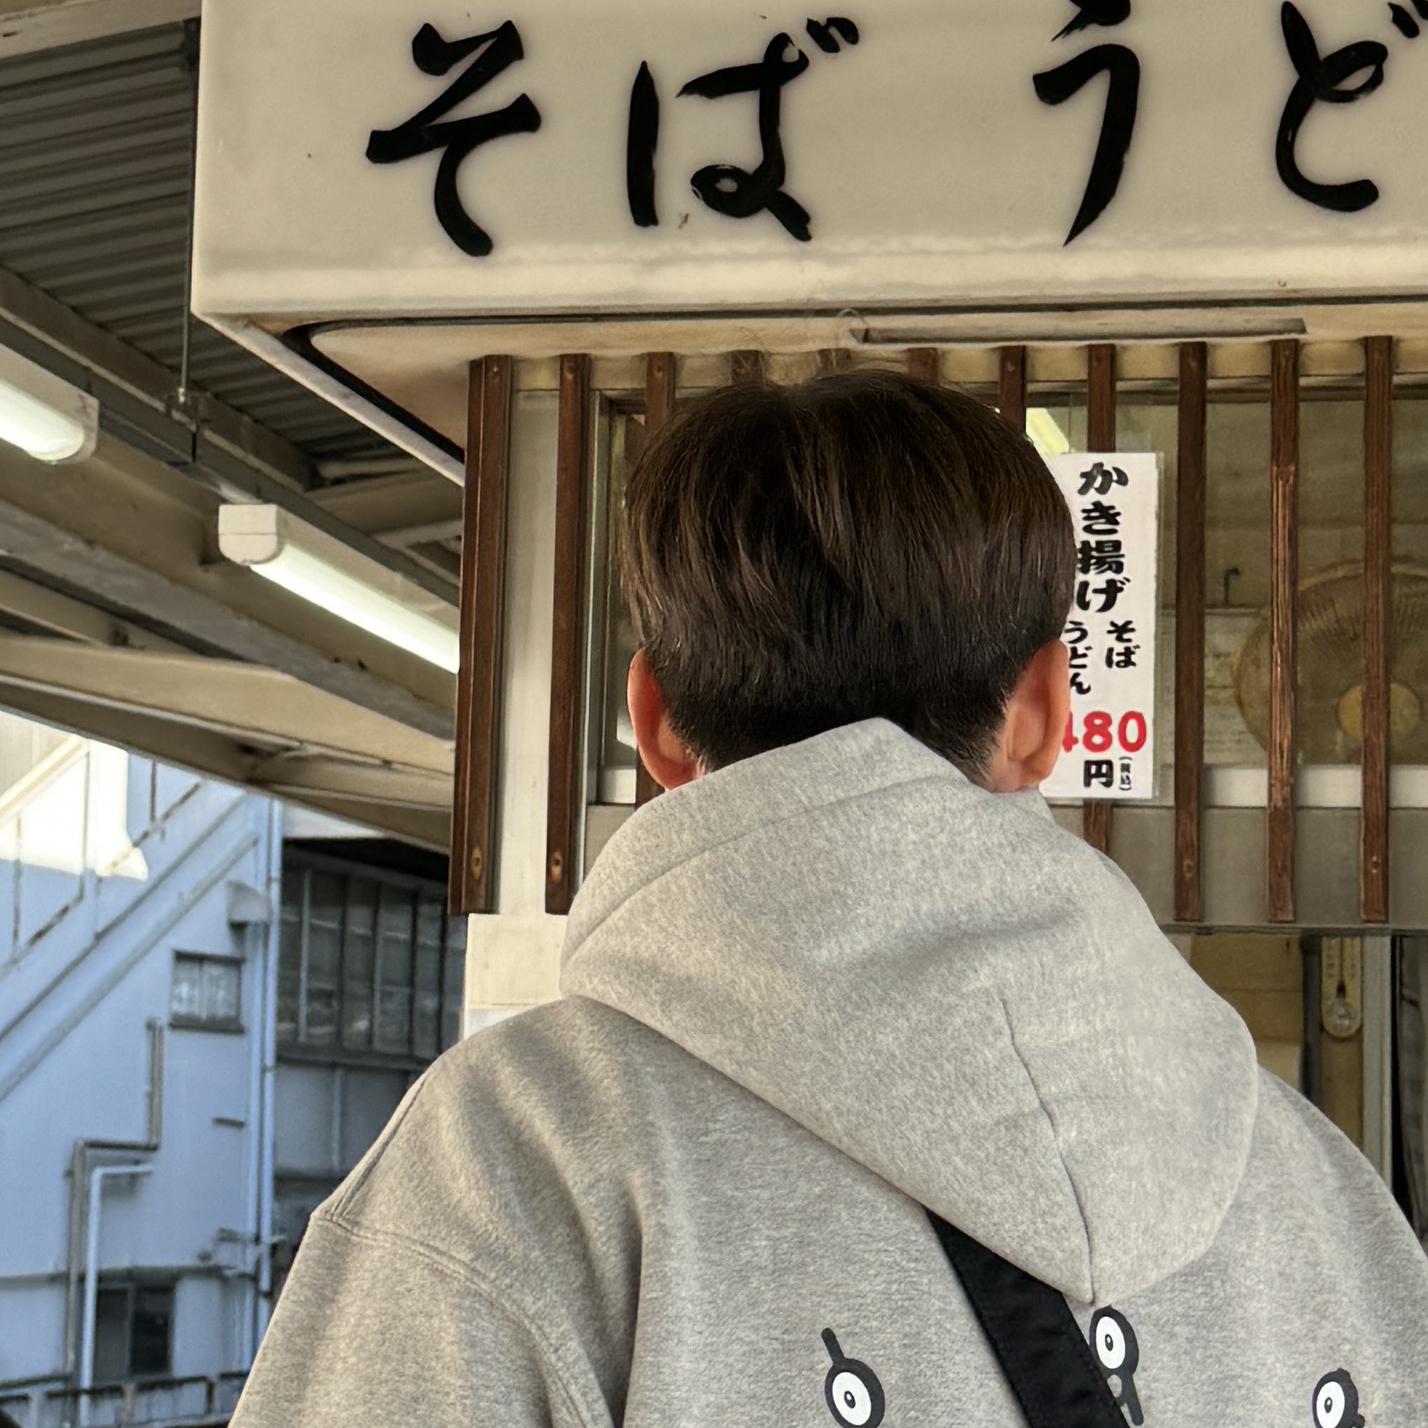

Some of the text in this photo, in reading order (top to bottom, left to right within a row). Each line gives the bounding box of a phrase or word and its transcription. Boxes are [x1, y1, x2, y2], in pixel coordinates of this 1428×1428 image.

[364, 15, 862, 258] そば
[1073, 461, 1131, 613] かき揚げ
[1105, 620, 1141, 669] そば
[1083, 759, 1114, 788] 円
